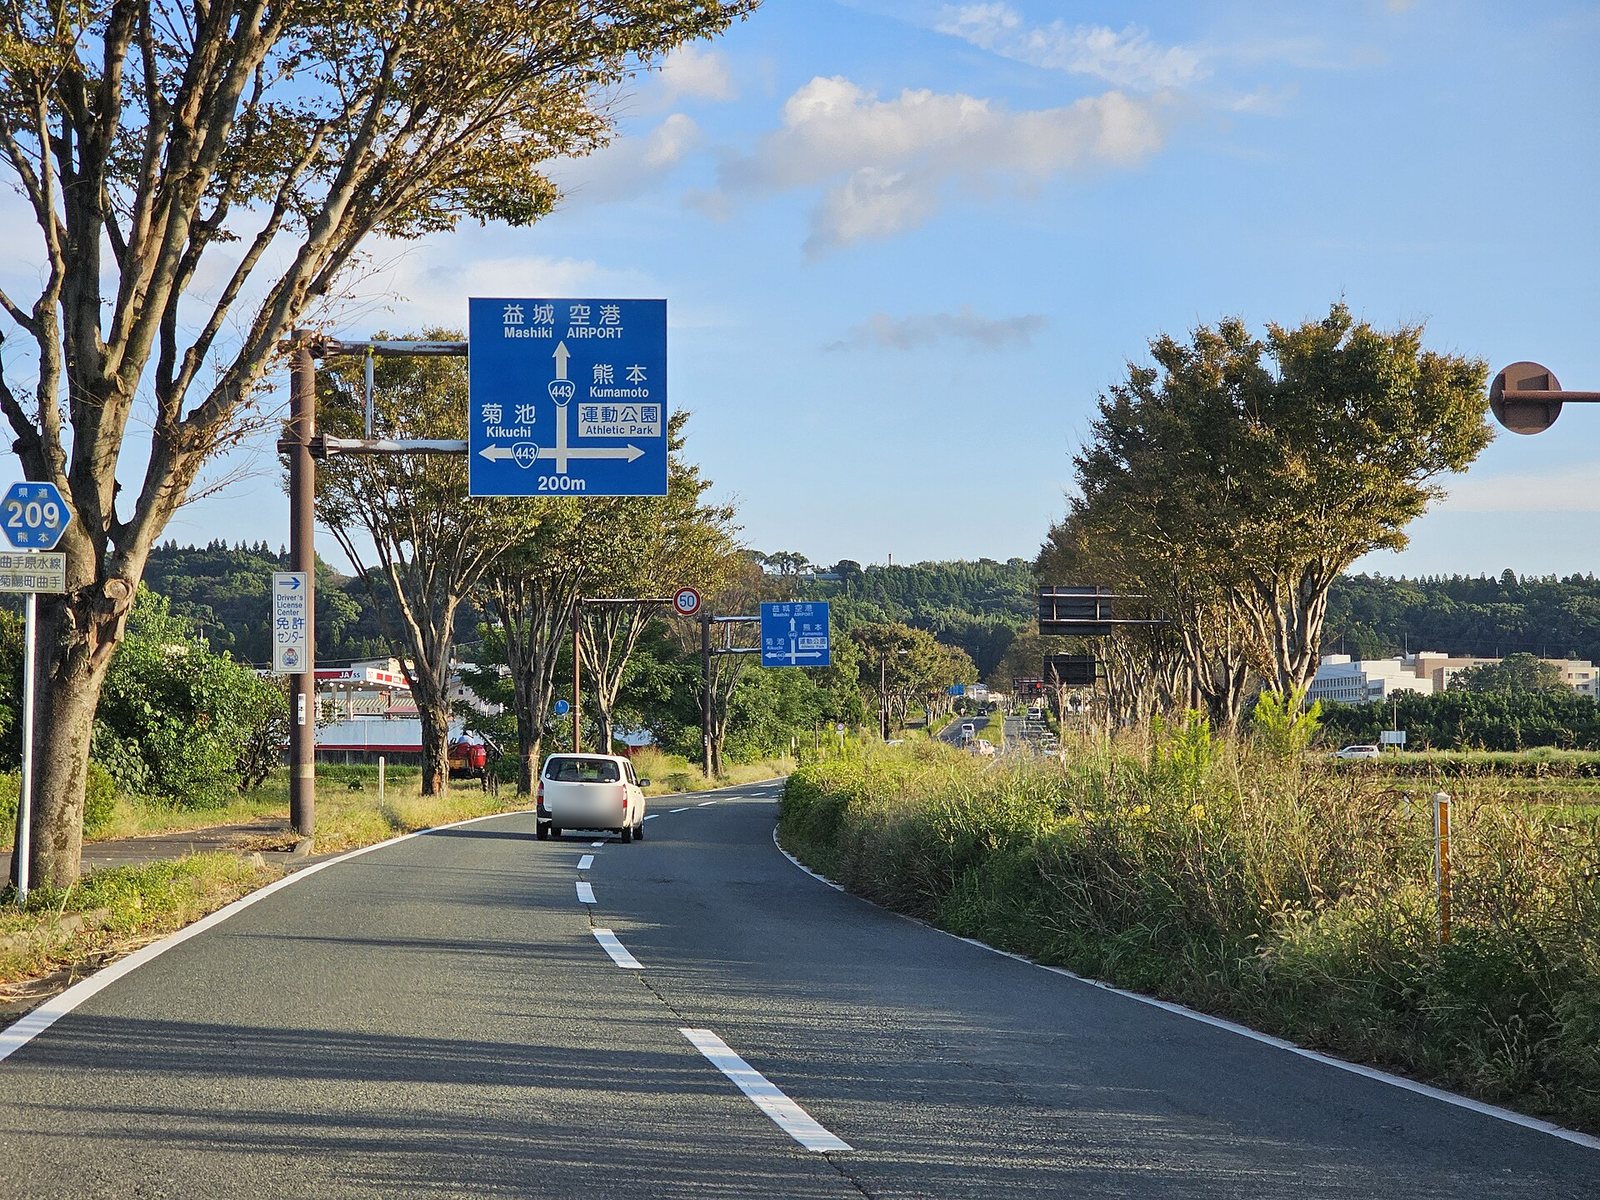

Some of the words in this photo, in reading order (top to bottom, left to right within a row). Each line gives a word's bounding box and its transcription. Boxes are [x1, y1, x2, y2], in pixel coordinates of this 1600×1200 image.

[503, 304, 555, 325] 益城
[569, 304, 621, 325] 空港
[504, 327, 553, 338] Mashiki
[566, 327, 624, 339] AIRPORT
[592, 364, 648, 385] 熊本
[552, 386, 571, 396] 443
[589, 386, 649, 398] Kumamoto
[481, 402, 536, 424] 菊池
[581, 406, 658, 423] 運動公園
[486, 426, 531, 438] Kikuchi
[585, 425, 625, 435] Athletic
[629, 426, 653, 435] Park
[515, 449, 536, 460] 443
[537, 476, 586, 491] 200m
[18, 487, 48, 499] 県道
[7, 501, 60, 529] 209
[17, 532, 49, 543] 熊本
[679, 595, 695, 608] 50
[276, 617, 305, 630] 免許
[277, 631, 304, 644] センター
[339, 671, 350, 679] JA
